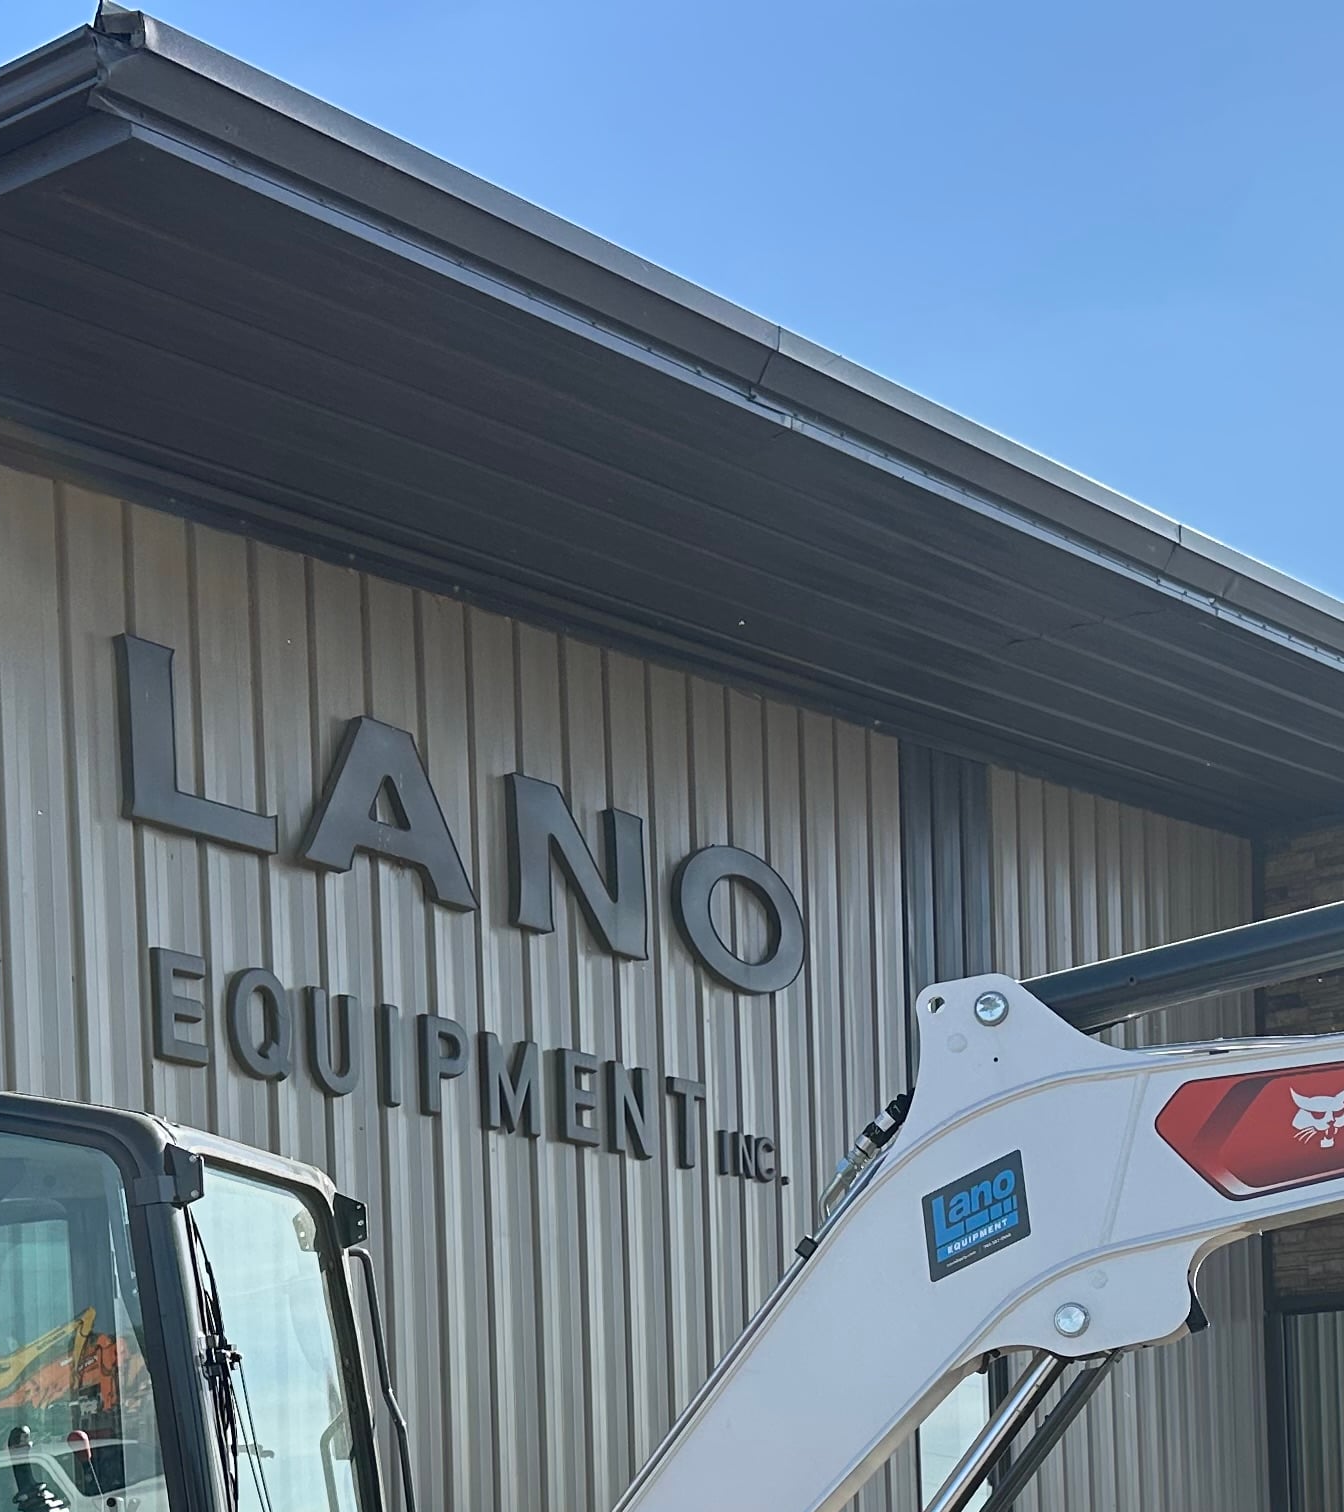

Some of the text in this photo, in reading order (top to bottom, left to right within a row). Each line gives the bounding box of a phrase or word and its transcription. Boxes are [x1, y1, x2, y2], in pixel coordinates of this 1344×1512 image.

[114, 633, 805, 995] LANO
[149, 946, 790, 1186] EQUIPMENT INC.
[932, 1168, 1016, 1248] Lano
[947, 1218, 1008, 1254] EQUIPMENT
